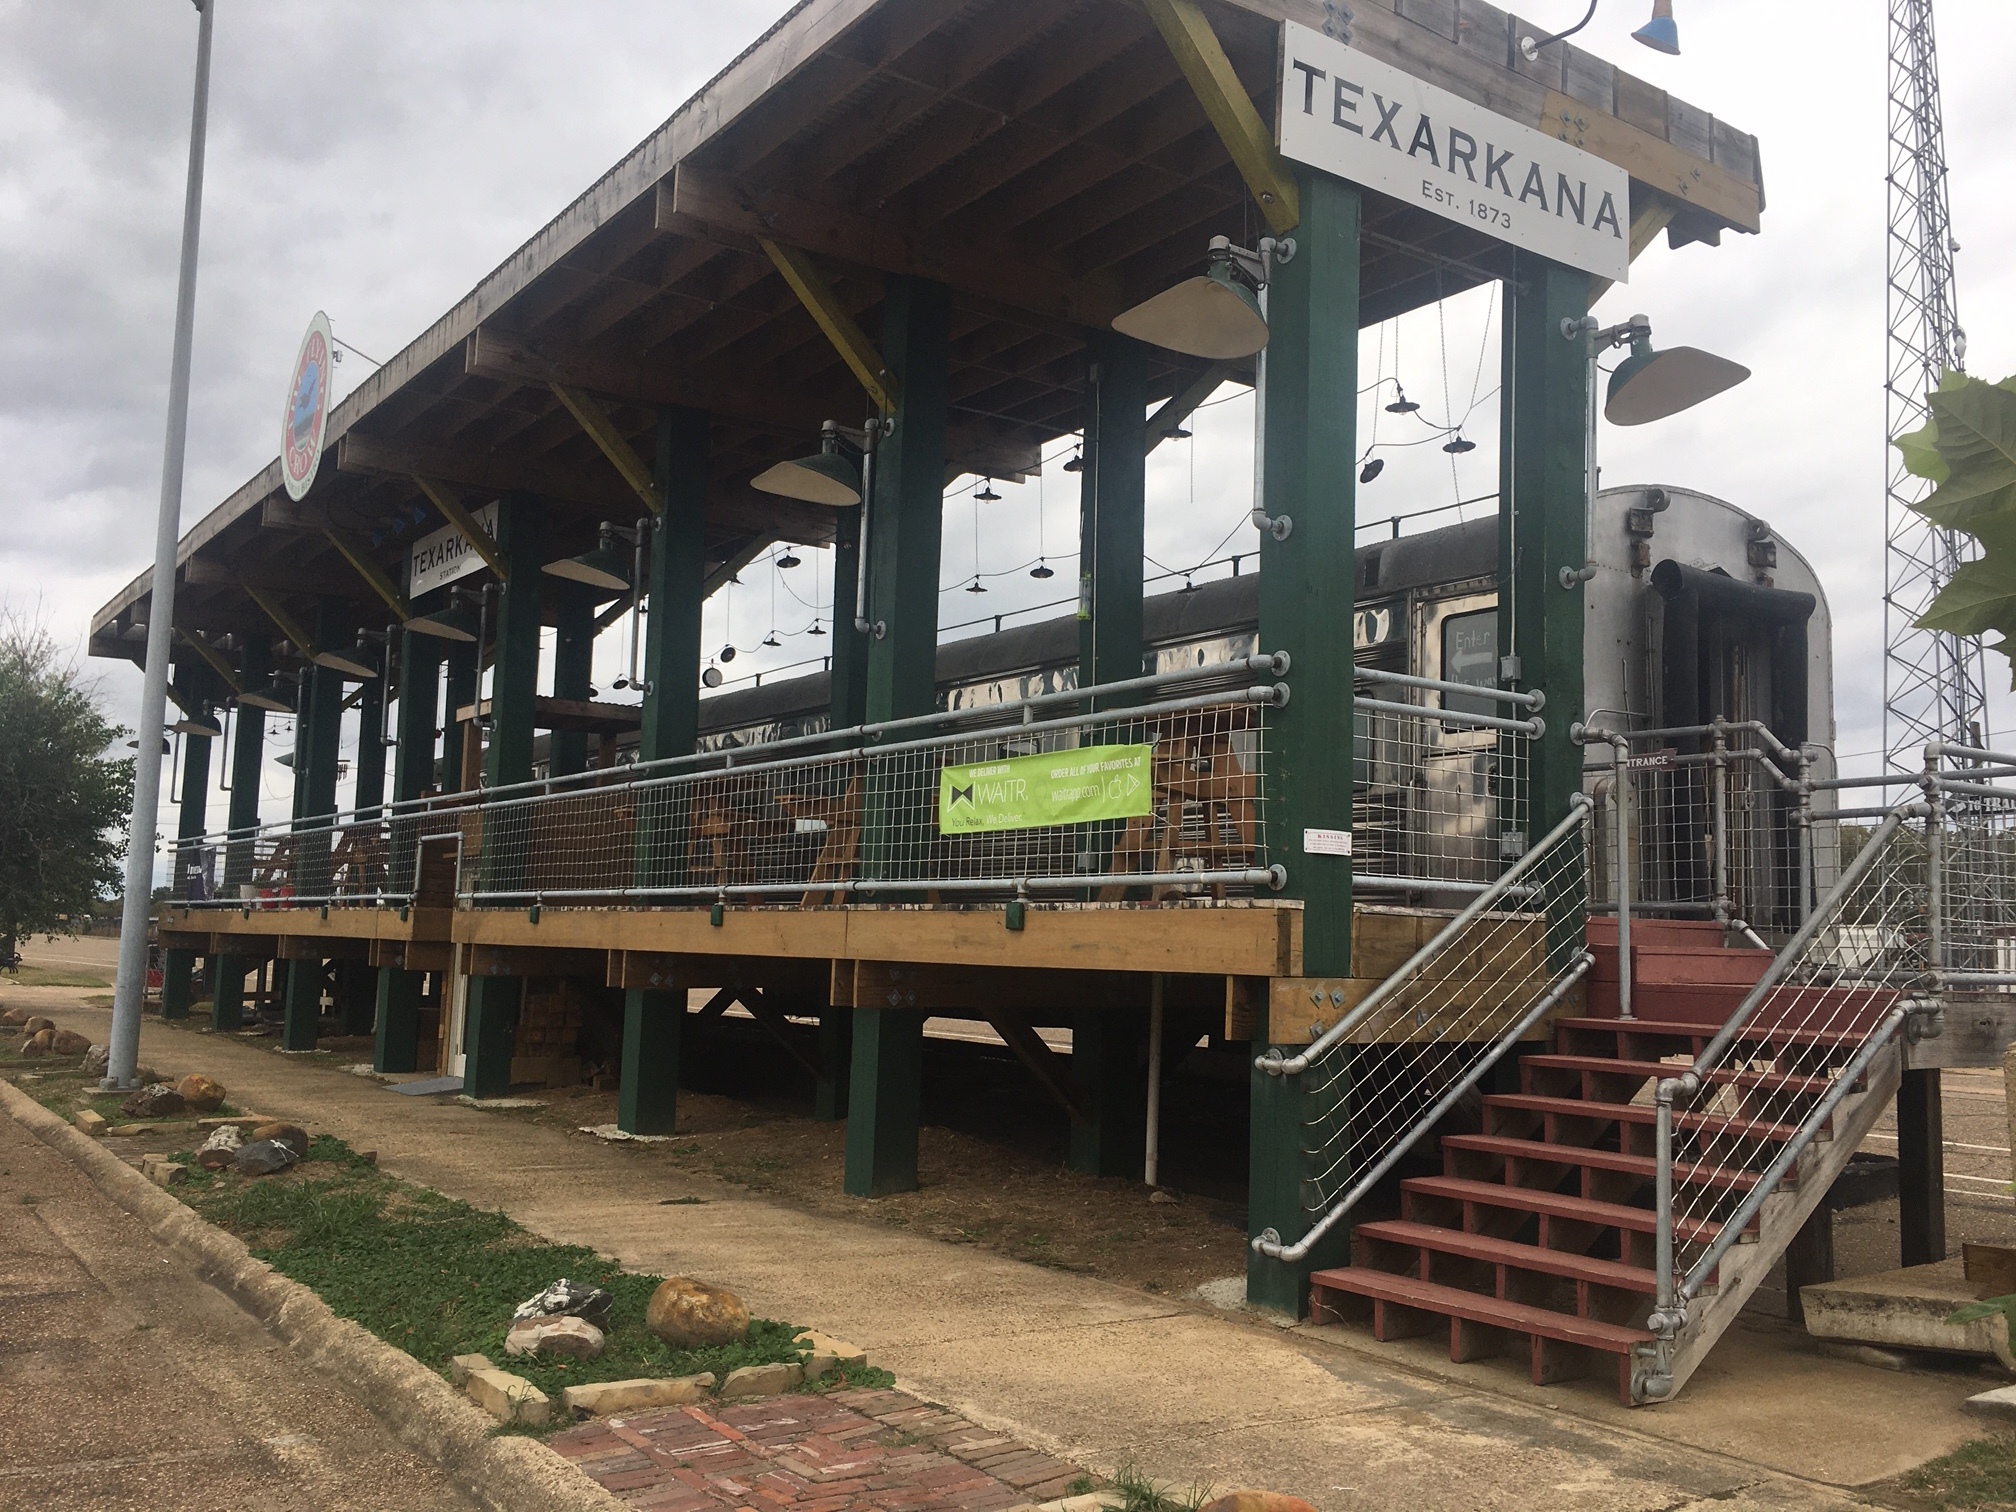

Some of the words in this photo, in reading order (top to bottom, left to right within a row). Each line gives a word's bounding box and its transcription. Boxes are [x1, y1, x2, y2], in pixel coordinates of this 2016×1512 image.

[1293, 58, 1623, 239] TEXARKANA
[1422, 180, 1459, 210] EST.
[1469, 199, 1512, 230] 1873
[289, 429, 316, 475] CROW
[413, 518, 496, 577] TEXARKAA
[439, 565, 462, 580] STATION
[1456, 630, 1490, 650] Enter
[1051, 769, 1069, 779] ORDER
[1069, 767, 1079, 777] ALL
[1080, 766, 1087, 775] OF
[1086, 763, 1100, 774] YOUR
[1100, 758, 1133, 771] FAVORITES
[1133, 756, 1142, 767] AT
[1627, 756, 1668, 767] NTRANCE
[969, 769, 977, 778] WE
[978, 766, 997, 777] DELIVER
[1052, 785, 1100, 802] waitrapp.com
[1984, 797, 2016, 811] TRAI
[952, 818, 965, 828] You
[966, 816, 985, 827] Relax,
[986, 814, 997, 824] We
[998, 812, 1023, 824] Deliver.
